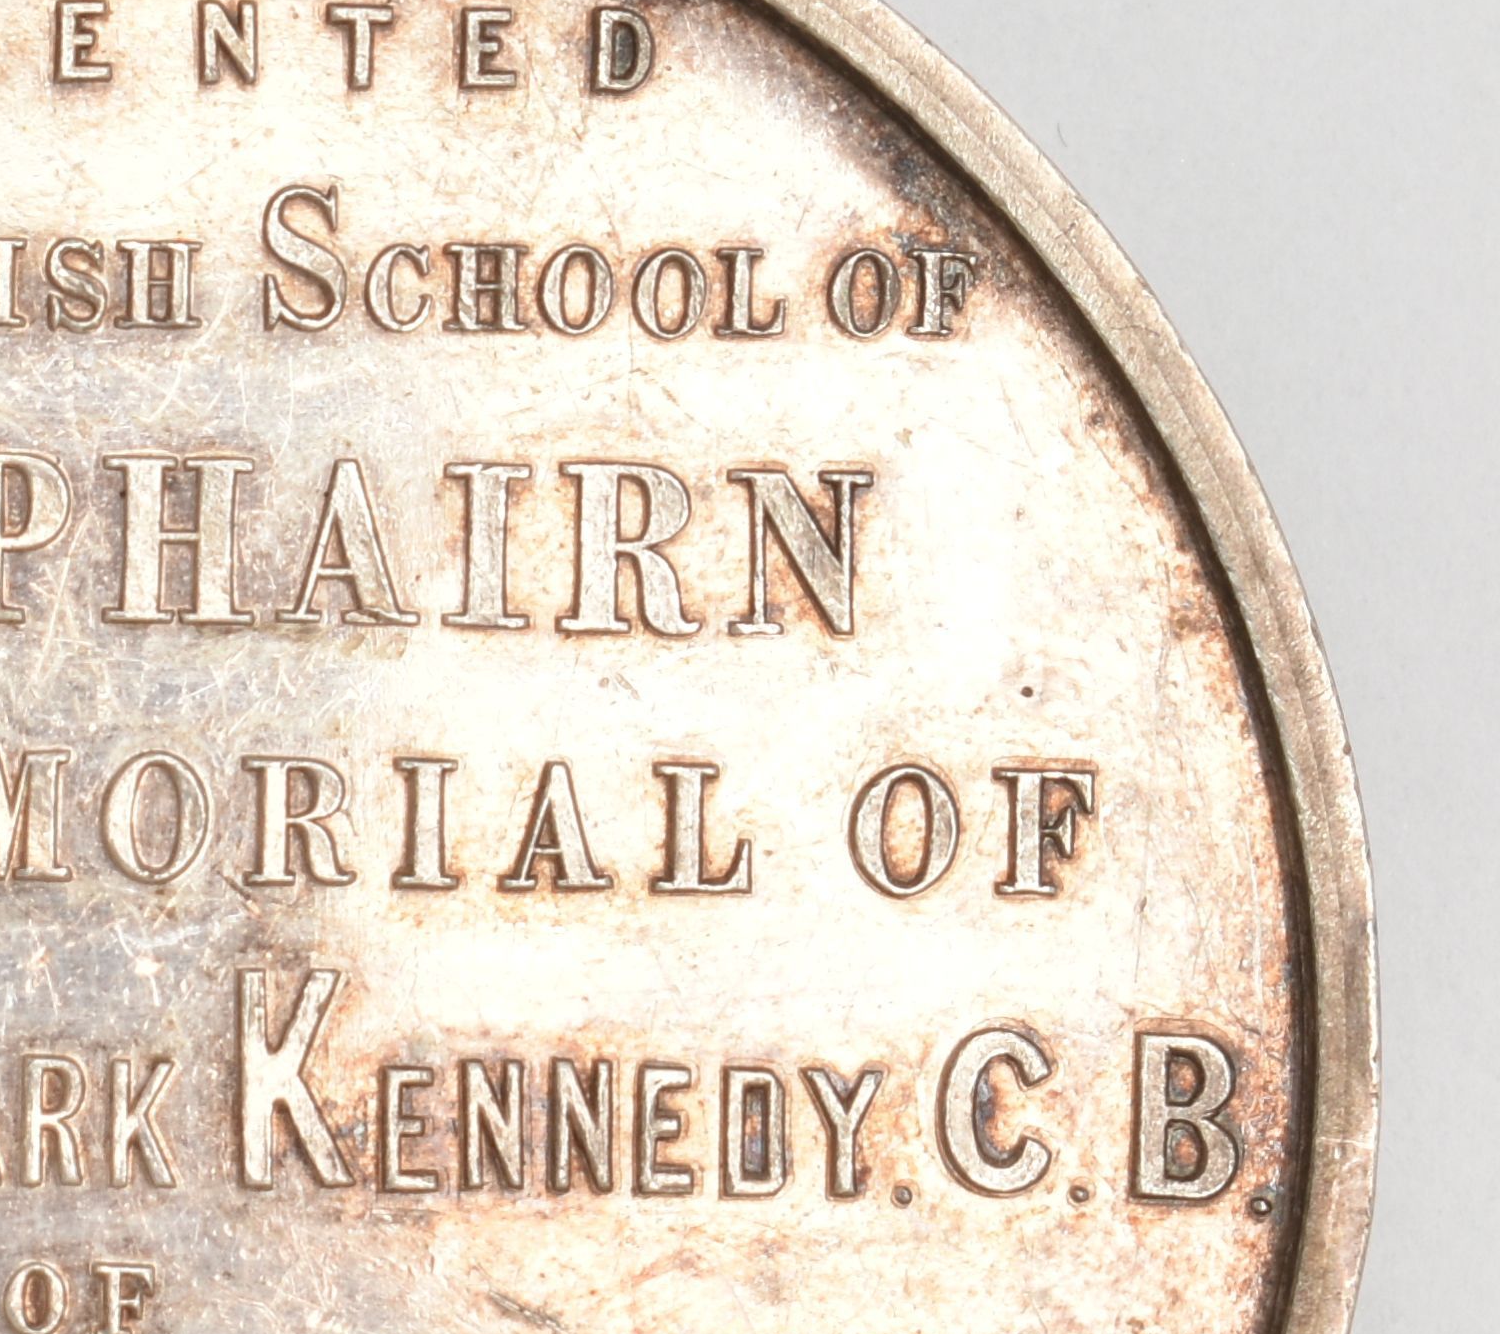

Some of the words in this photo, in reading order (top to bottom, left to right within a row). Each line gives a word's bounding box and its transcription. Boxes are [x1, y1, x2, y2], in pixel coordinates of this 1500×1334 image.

[261, 183, 786, 338] SCHOOL
[828, 248, 978, 340] OF
[849, 761, 1096, 899] OF
